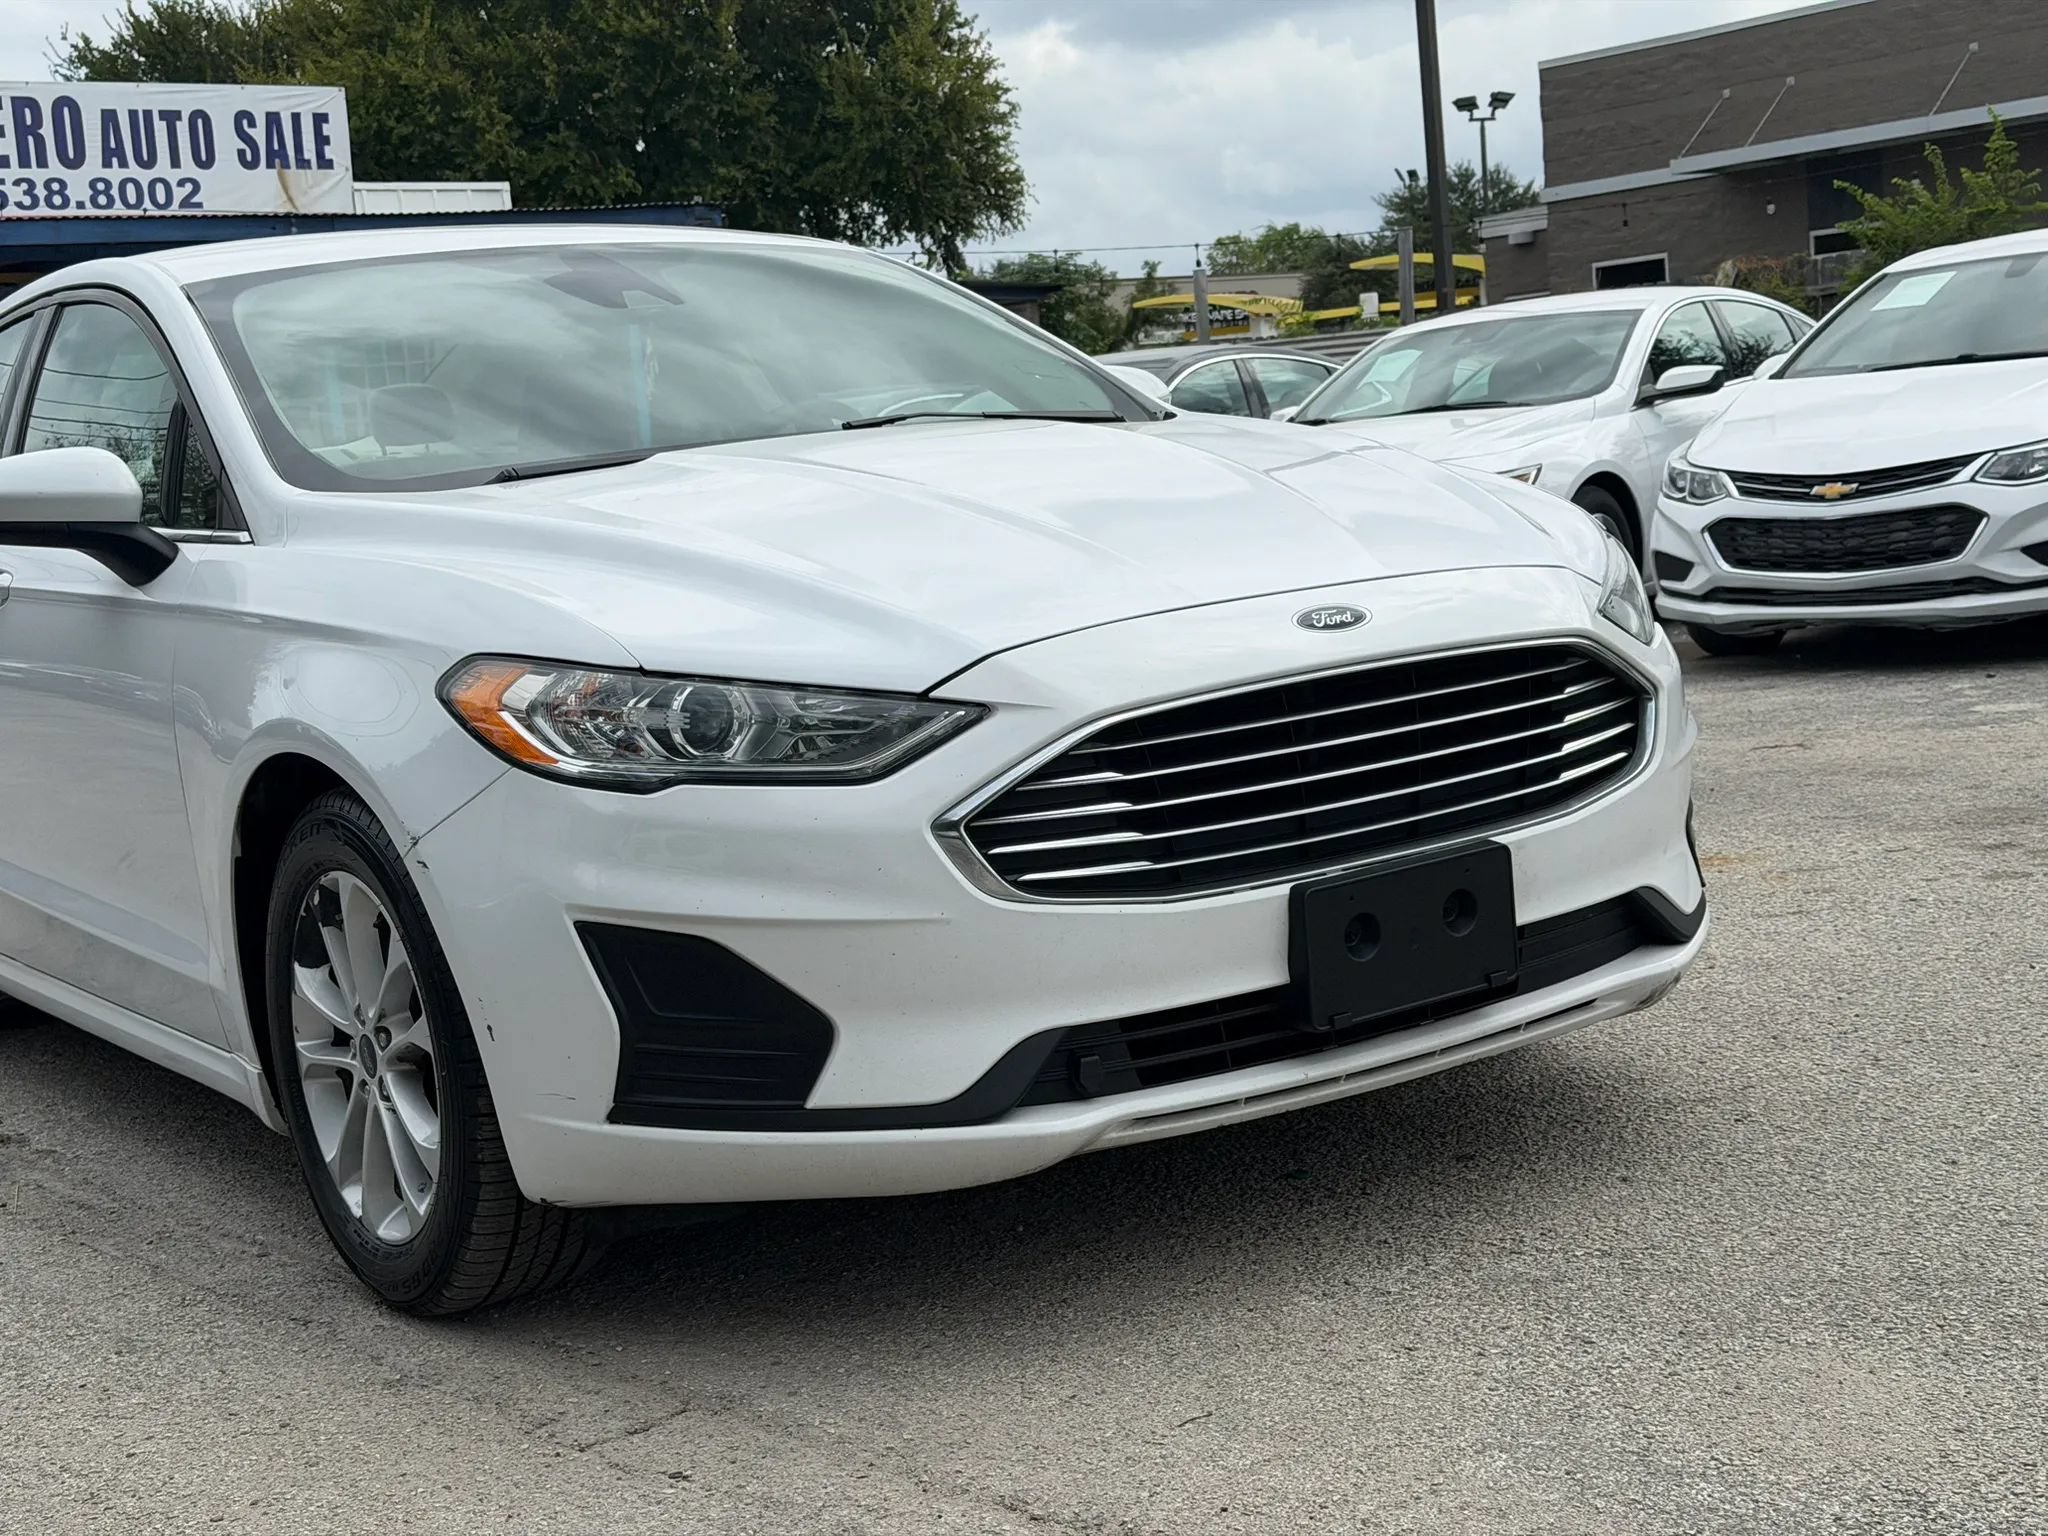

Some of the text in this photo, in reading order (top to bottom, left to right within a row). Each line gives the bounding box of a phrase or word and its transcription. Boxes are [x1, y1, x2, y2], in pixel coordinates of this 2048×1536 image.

[0, 95, 335, 170] RO AUTO SALE
[1312, 609, 1354, 627] Ford
